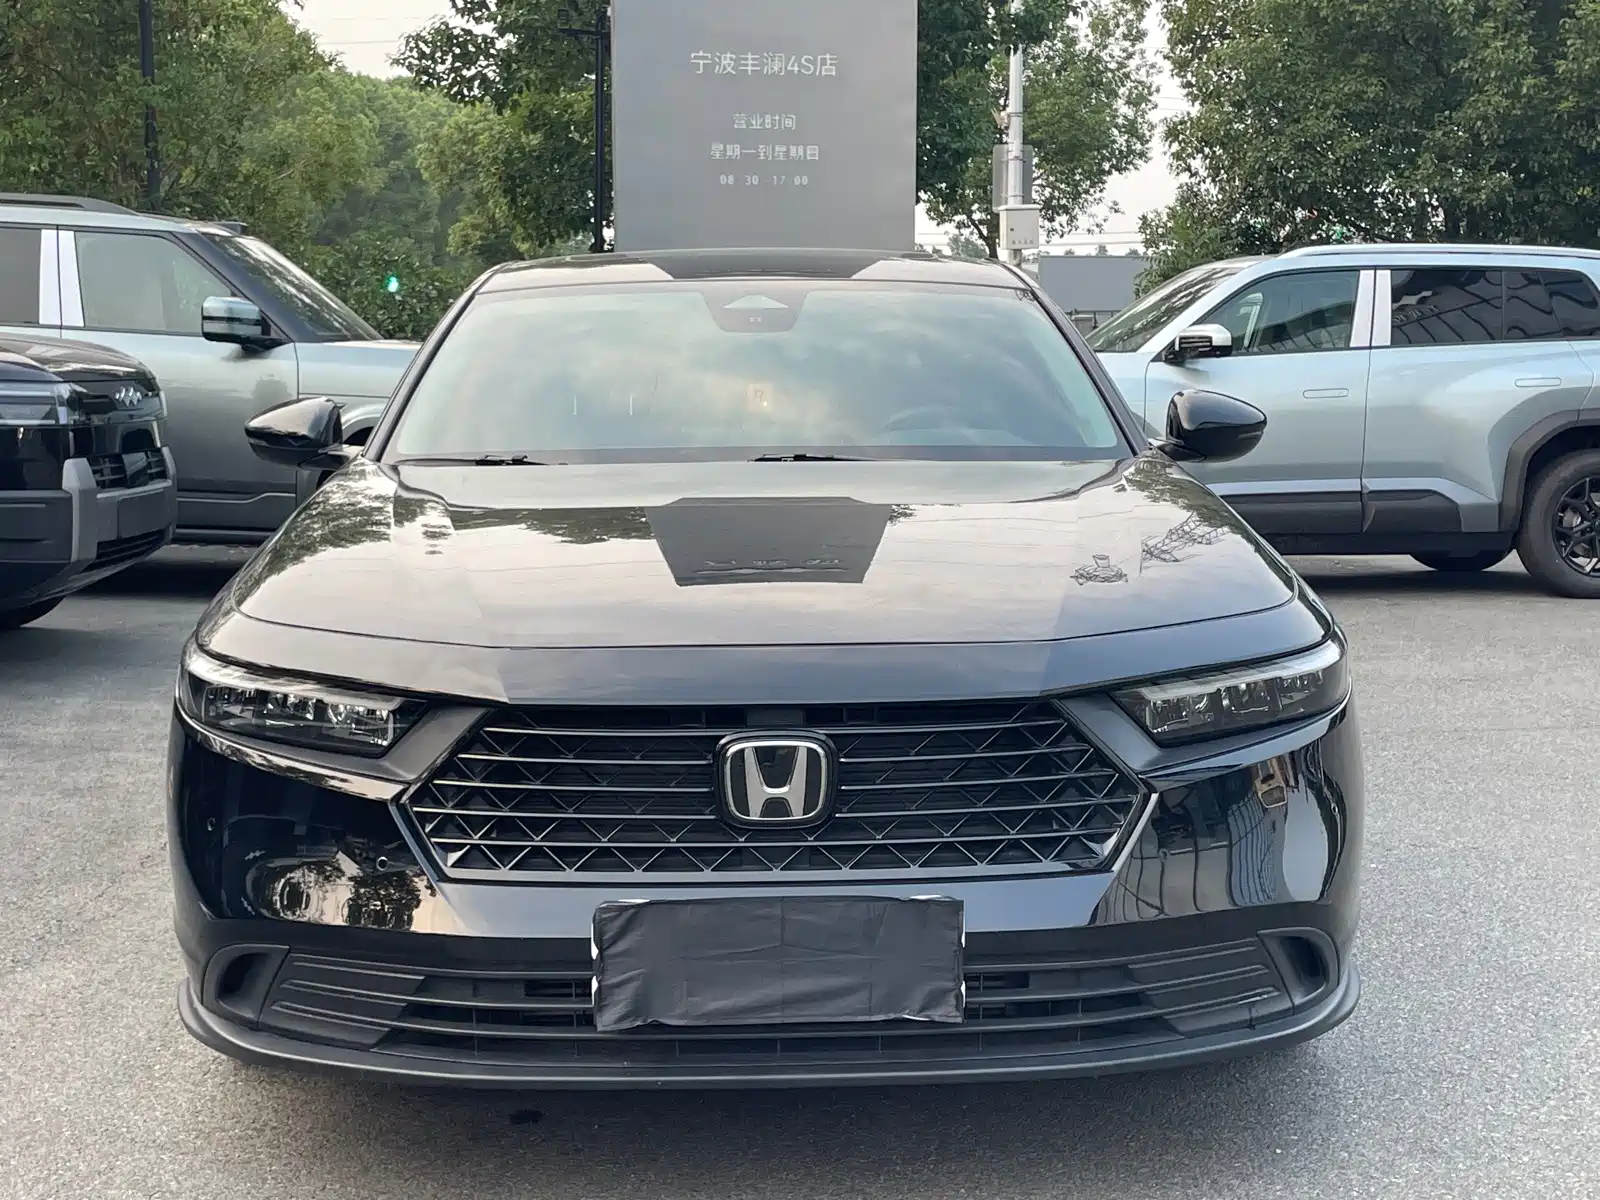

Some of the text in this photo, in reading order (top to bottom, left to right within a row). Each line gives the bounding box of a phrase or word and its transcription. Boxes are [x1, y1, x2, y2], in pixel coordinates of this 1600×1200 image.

[690, 50, 838, 76] 宁波丰澜4S店
[732, 112, 796, 130] 营业时间
[710, 143, 819, 160] 星期一到星期日
